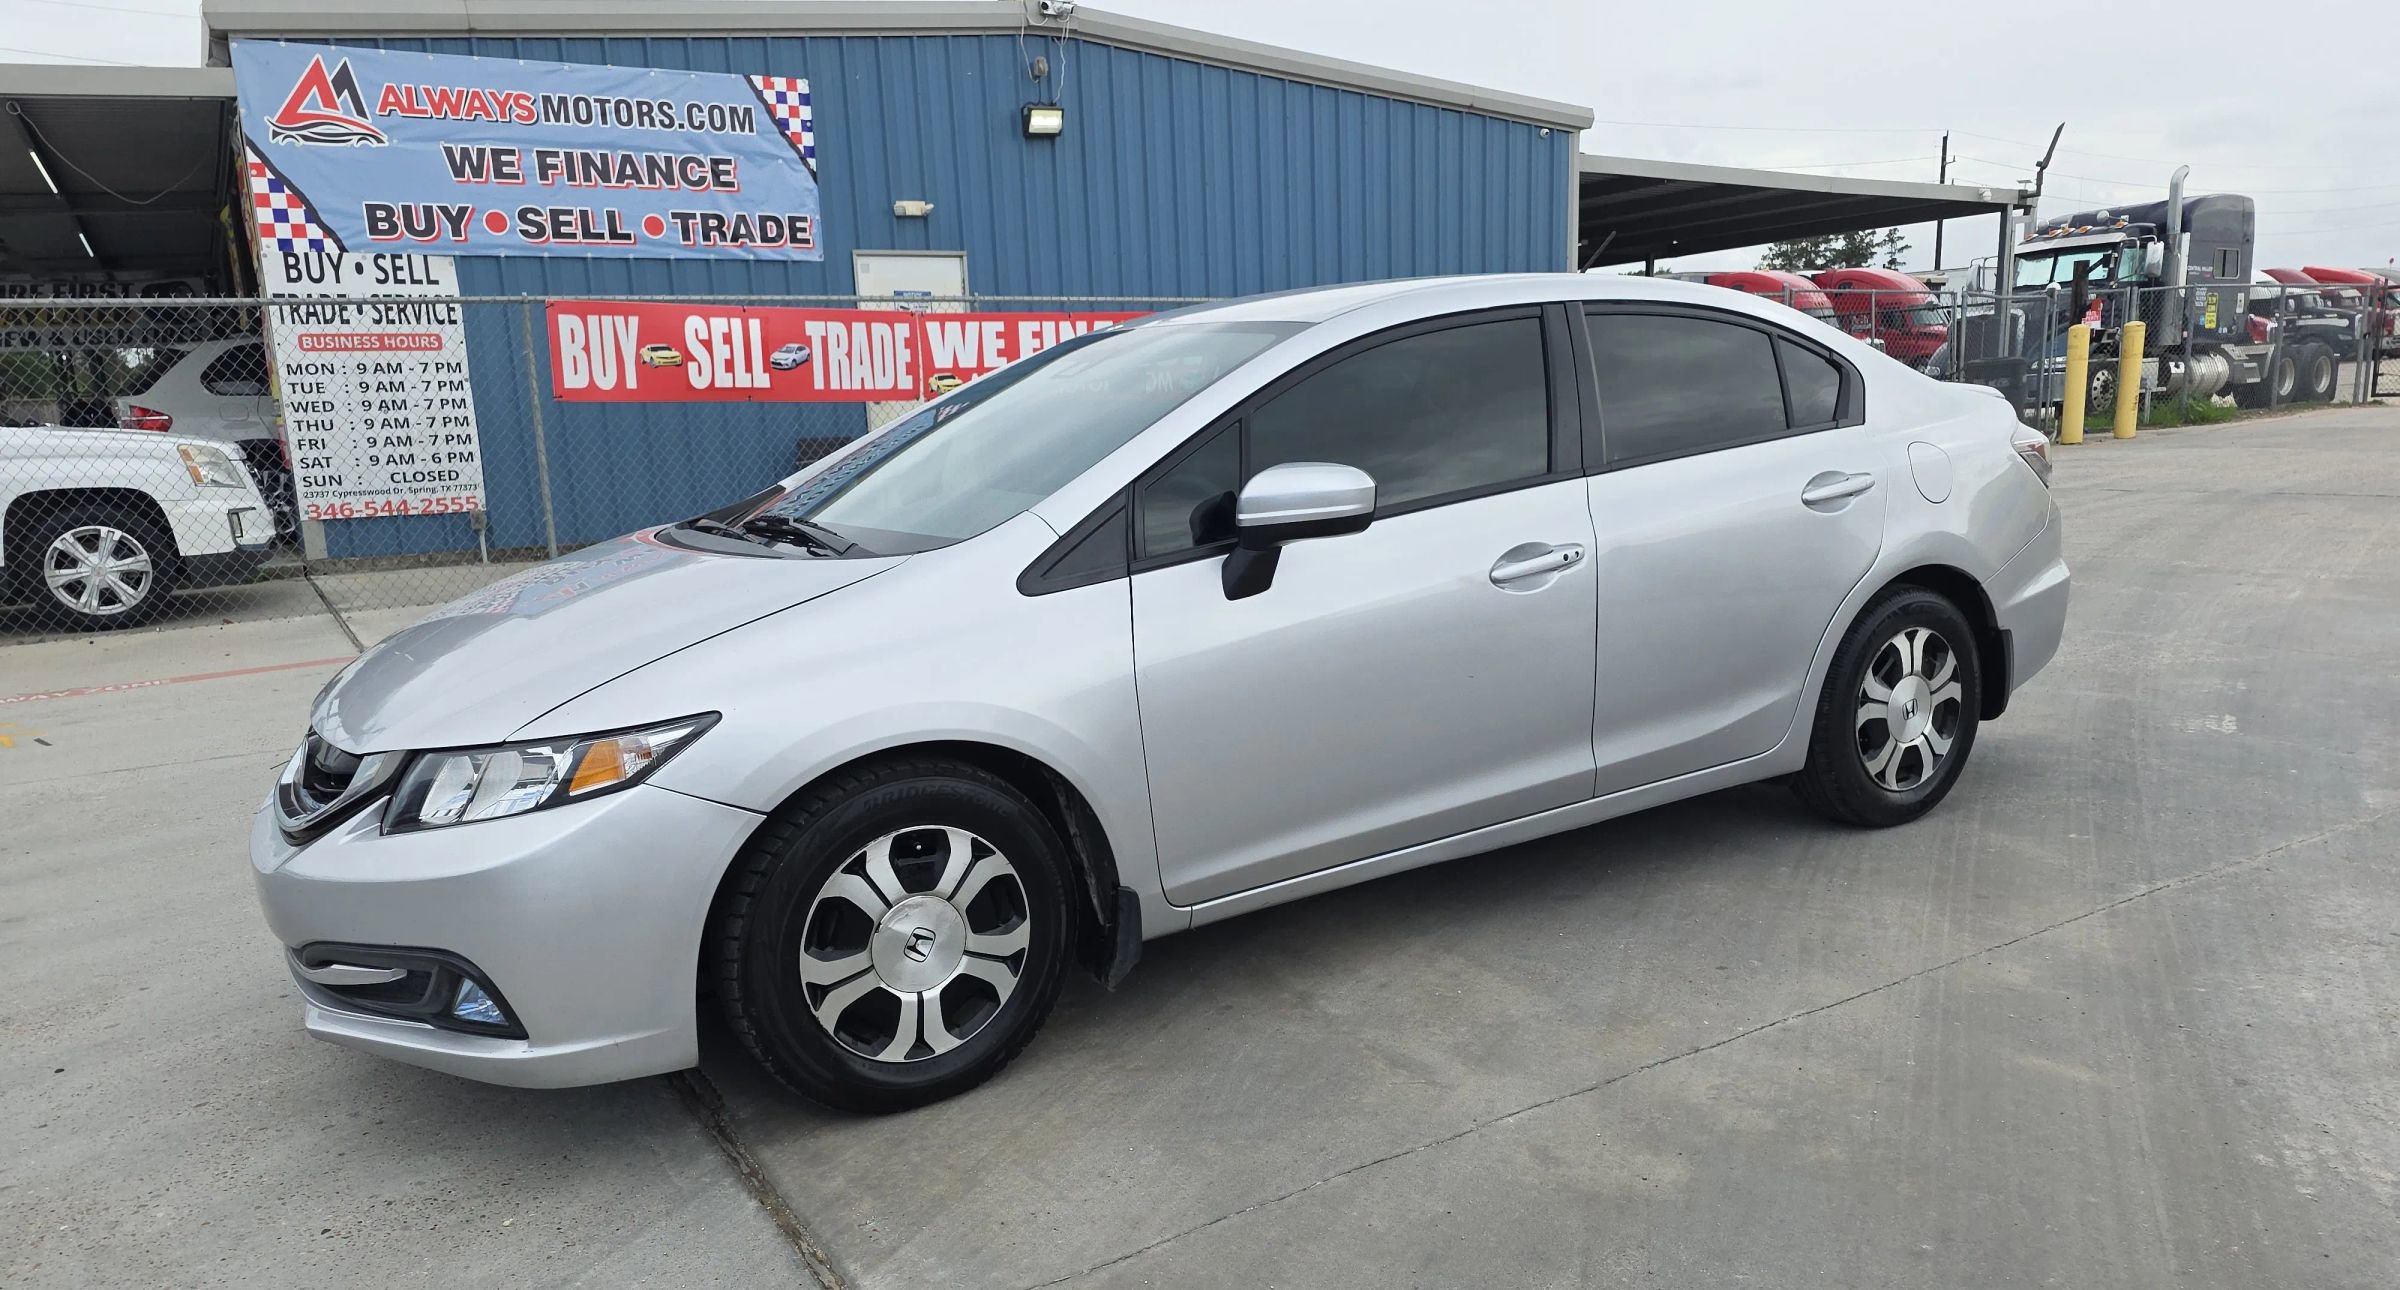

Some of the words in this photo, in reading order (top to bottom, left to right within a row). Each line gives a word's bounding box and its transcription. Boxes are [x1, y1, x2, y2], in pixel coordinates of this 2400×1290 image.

[443, 143, 524, 184] WE
[535, 149, 740, 192] FINANCE
[363, 202, 474, 242] BUY
[516, 206, 638, 246] SELL
[670, 211, 815, 249] TRADE
[283, 253, 343, 283] BUY
[373, 254, 439, 285] SELL
[273, 293, 350, 325] TRADE
[372, 294, 457, 325] SERVICE
[302, 337, 380, 348] BUSINESS
[384, 337, 439, 348] HOURS
[926, 320, 1008, 368] WE
[557, 313, 640, 390] BUY
[684, 317, 771, 389] SELL
[805, 321, 914, 391] TRADE
[286, 363, 334, 375] MON
[356, 363, 367, 374] 9
[374, 363, 402, 374] AM
[419, 363, 428, 374] 7
[435, 362, 462, 373] PM
[288, 382, 325, 394] TUE
[359, 381, 369, 393] 9
[376, 381, 405, 392] AM
[421, 381, 431, 392] 7
[438, 380, 464, 392] PM
[291, 401, 334, 412] WED
[361, 400, 372, 411] 9
[379, 399, 407, 411] AM
[424, 399, 434, 410] 7
[441, 398, 467, 409] PM
[293, 420, 334, 432] THU
[364, 418, 374, 430] 9
[381, 417, 409, 429] AM
[427, 417, 436, 428] 7
[443, 416, 469, 427] PM
[298, 439, 325, 450] FRI
[367, 437, 377, 448] 9
[383, 436, 412, 447] AM
[429, 435, 439, 446] 7
[445, 434, 472, 445] PM
[300, 457, 332, 469] SAT
[369, 455, 380, 466] 9
[386, 454, 414, 465] AM
[431, 453, 442, 464] 6
[448, 452, 474, 463] PM
[303, 475, 342, 487] SUN
[390, 470, 459, 484] CLOSED
[332, 488, 391, 499] Cypresswood
[307, 496, 479, 520] 346-544-2555
